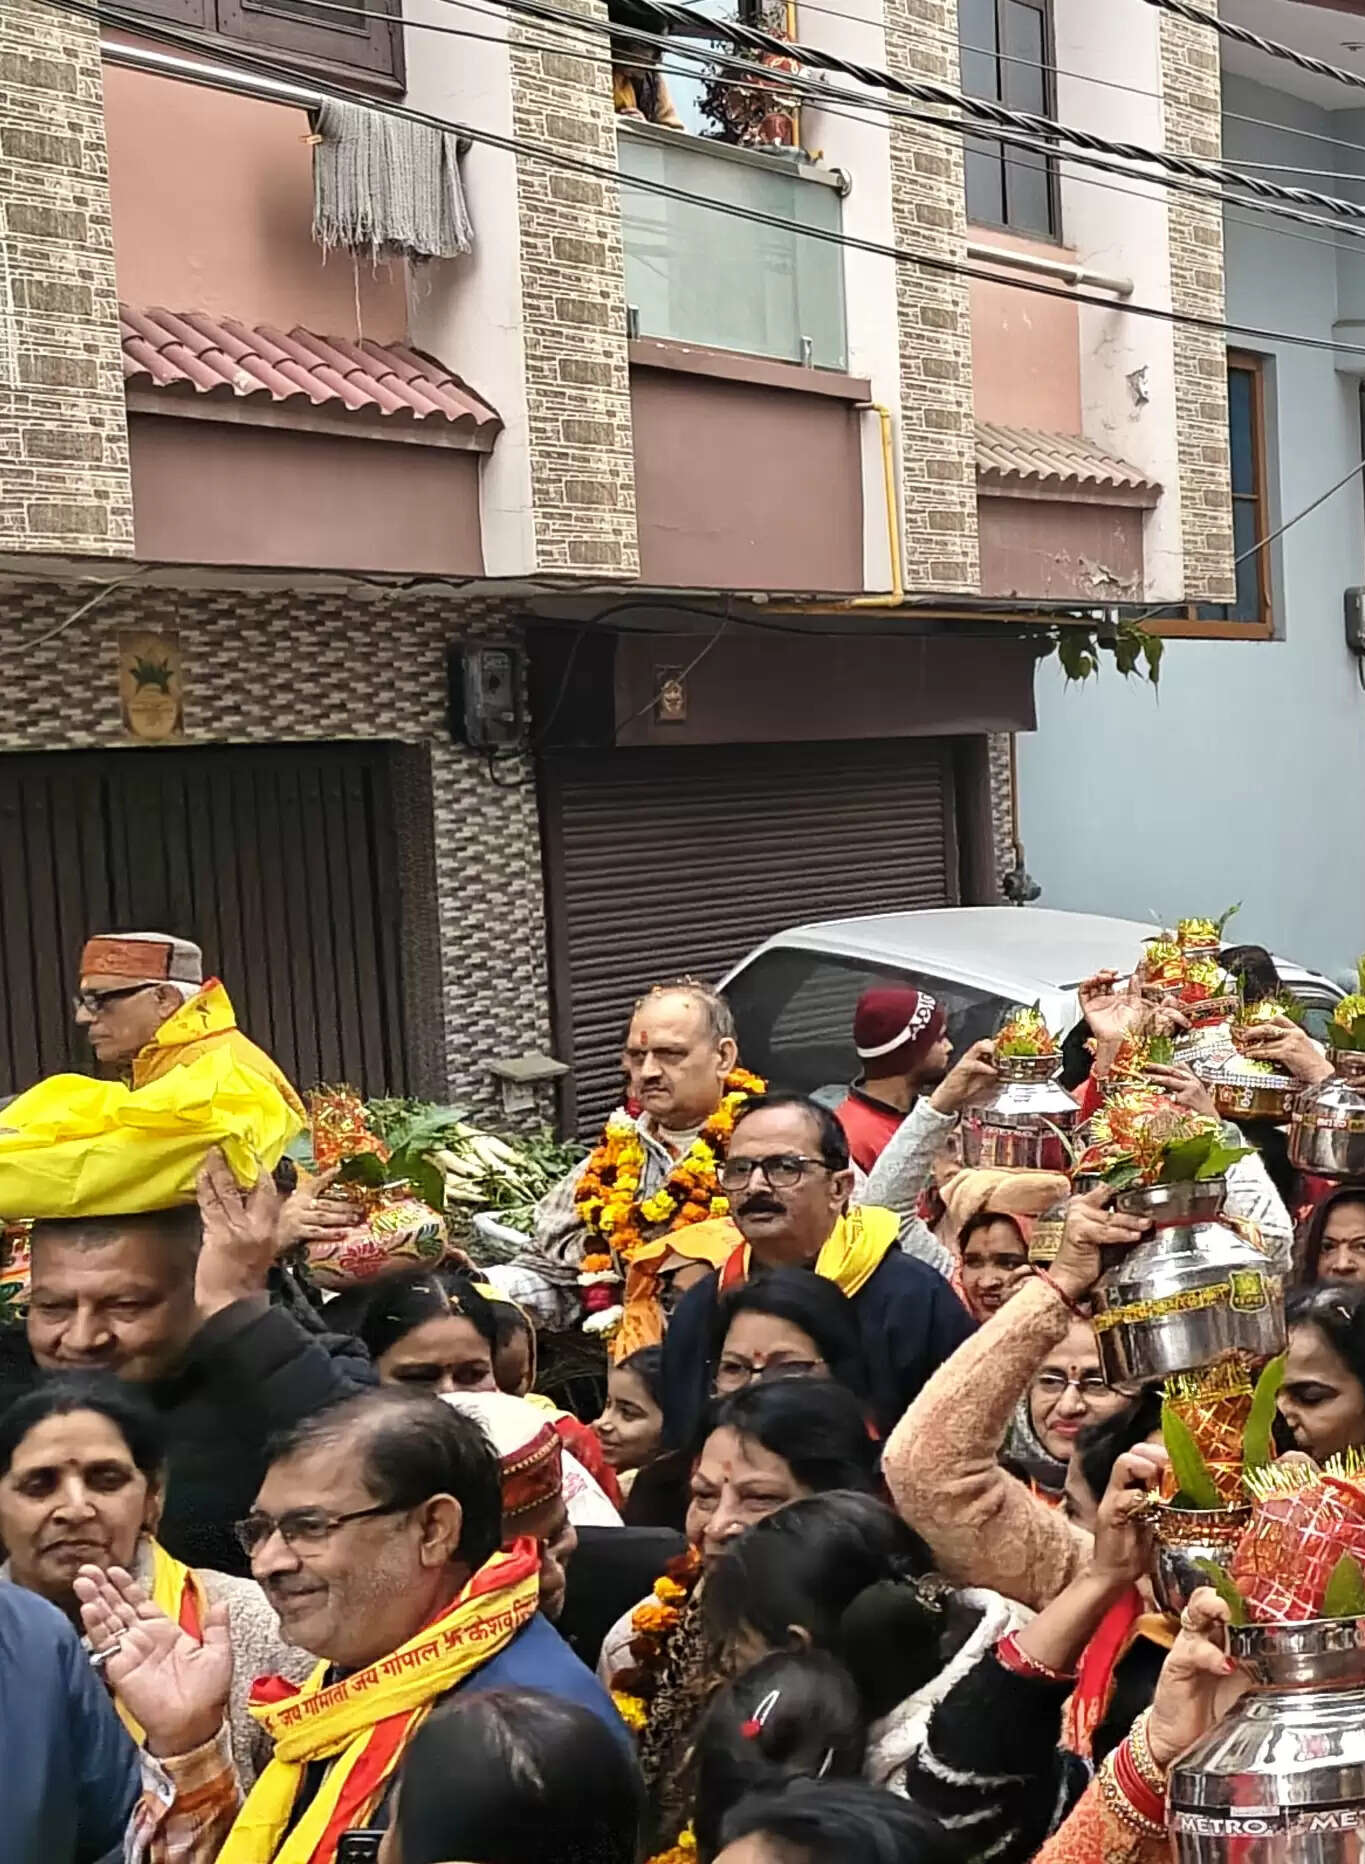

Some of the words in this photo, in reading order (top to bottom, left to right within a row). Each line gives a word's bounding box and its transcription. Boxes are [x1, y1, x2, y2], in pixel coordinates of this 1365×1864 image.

[278, 1708, 302, 1729] जय
[351, 1668, 379, 1692] जय
[1181, 1817, 1268, 1835] METRO
